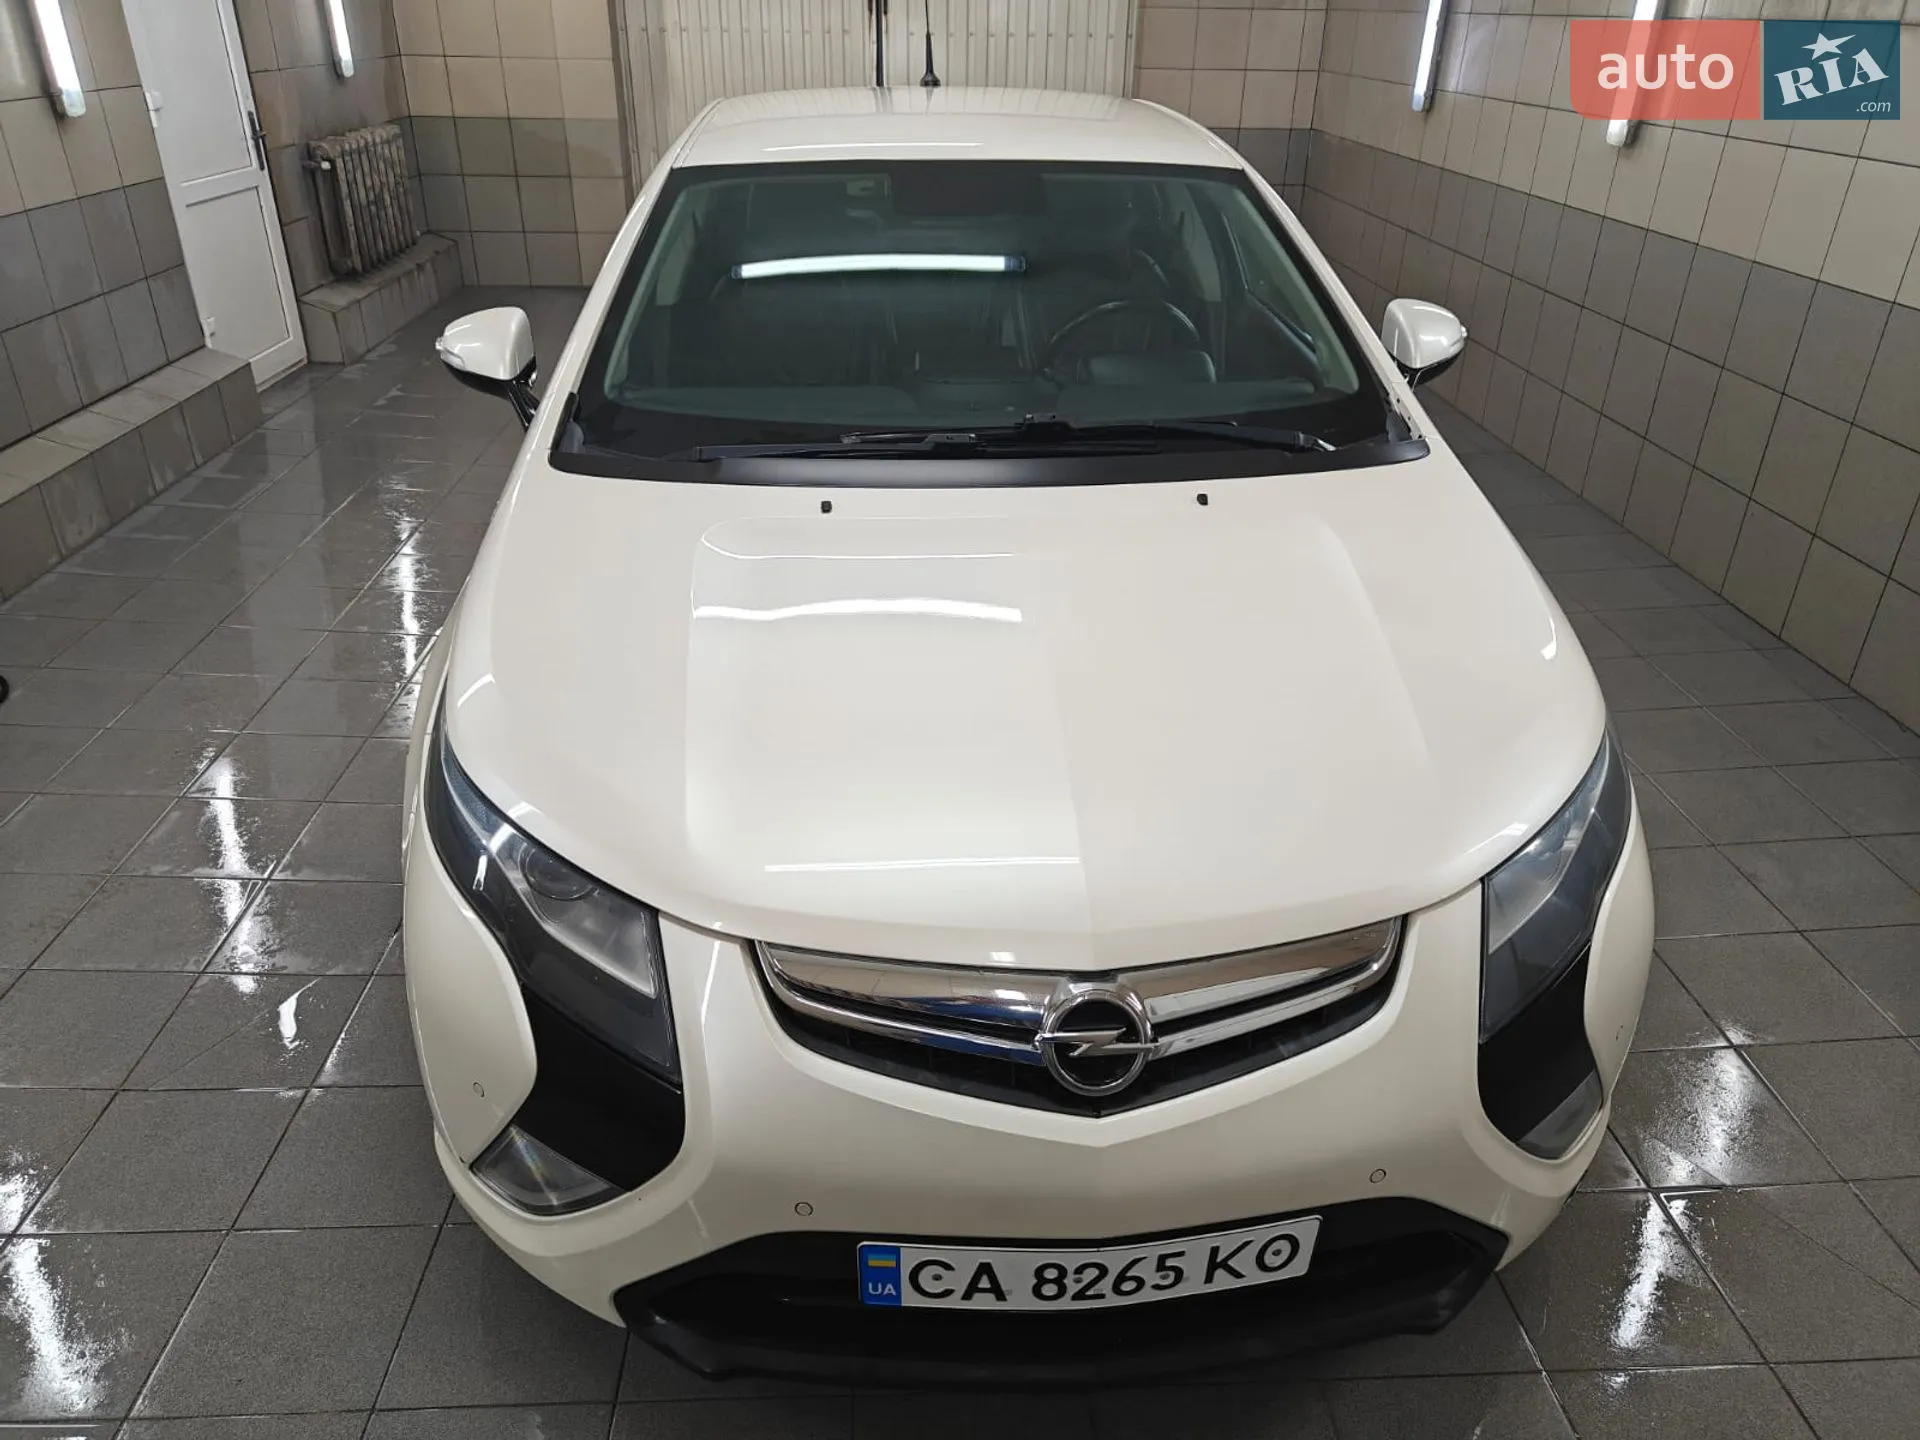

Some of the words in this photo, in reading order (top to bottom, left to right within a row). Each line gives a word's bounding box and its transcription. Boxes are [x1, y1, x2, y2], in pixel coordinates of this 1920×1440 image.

[908, 1258, 1008, 1302] CA
[1031, 1250, 1187, 1302] 8265
[1203, 1233, 1300, 1284] KO
[868, 1281, 897, 1297] UA
